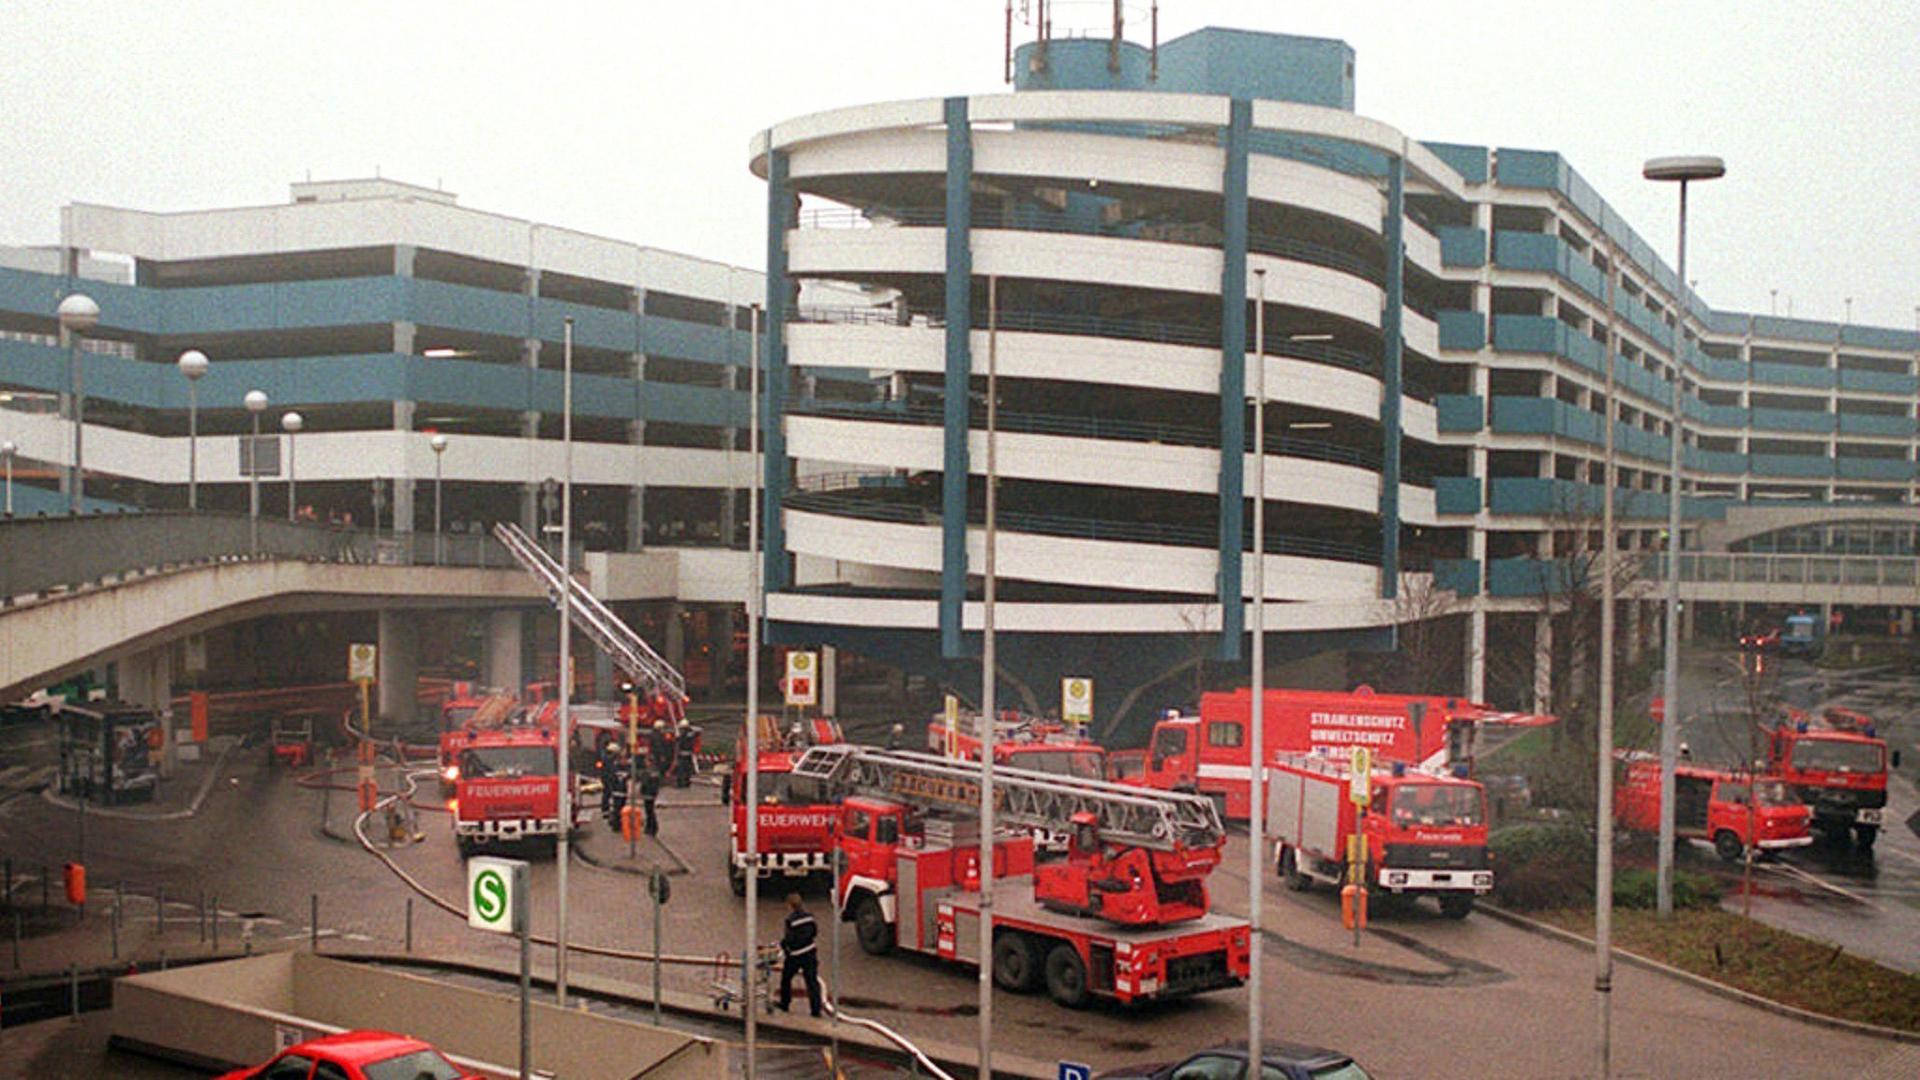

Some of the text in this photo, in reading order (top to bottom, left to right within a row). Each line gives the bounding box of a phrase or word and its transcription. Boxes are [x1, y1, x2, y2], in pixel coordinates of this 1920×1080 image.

[1311, 712, 1405, 730] STRAHLENSCHUTZ
[1311, 729, 1395, 746] UMWELTSCHUTZ
[466, 783, 551, 798] FEUERWEHR
[478, 874, 502, 919] S
